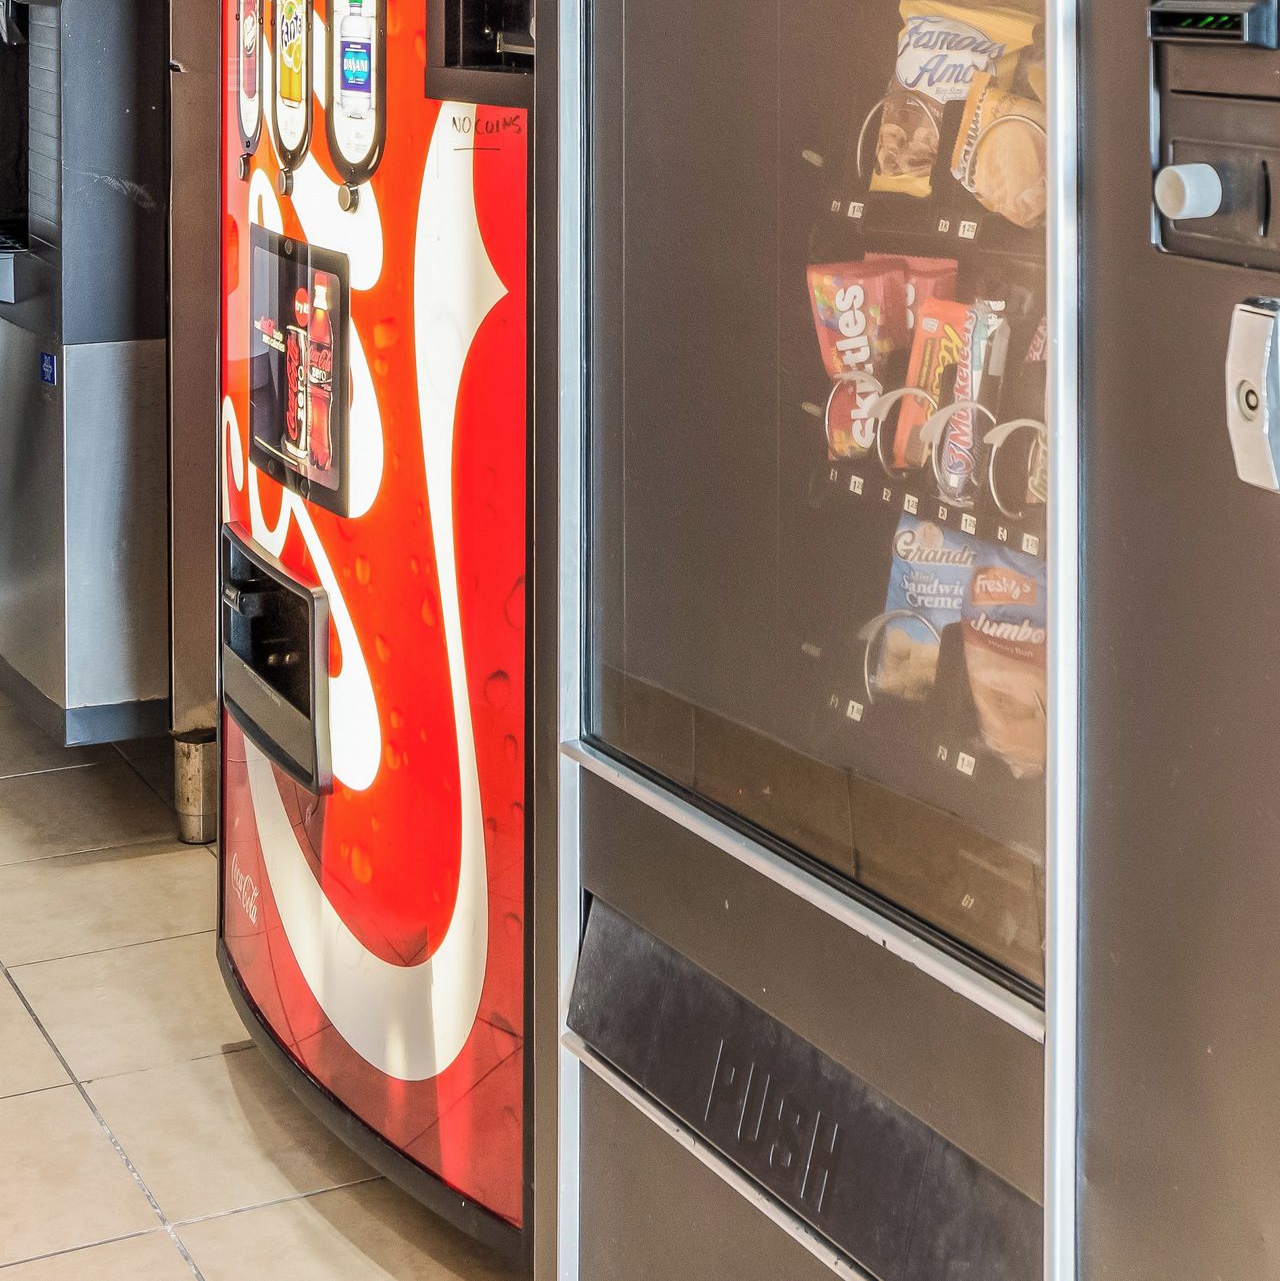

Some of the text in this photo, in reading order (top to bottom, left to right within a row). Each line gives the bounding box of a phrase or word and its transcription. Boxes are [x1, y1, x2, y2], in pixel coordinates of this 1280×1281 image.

[898, 15, 1008, 60] Famous
[343, 56, 369, 74] DASANI
[452, 116, 472, 134] NO
[944, 443, 976, 476] 3
[970, 613, 1045, 644] Jumbo
[231, 852, 260, 926] Coca-Cola
[961, 894, 975, 909] G1
[703, 1038, 839, 1214] PUSH
